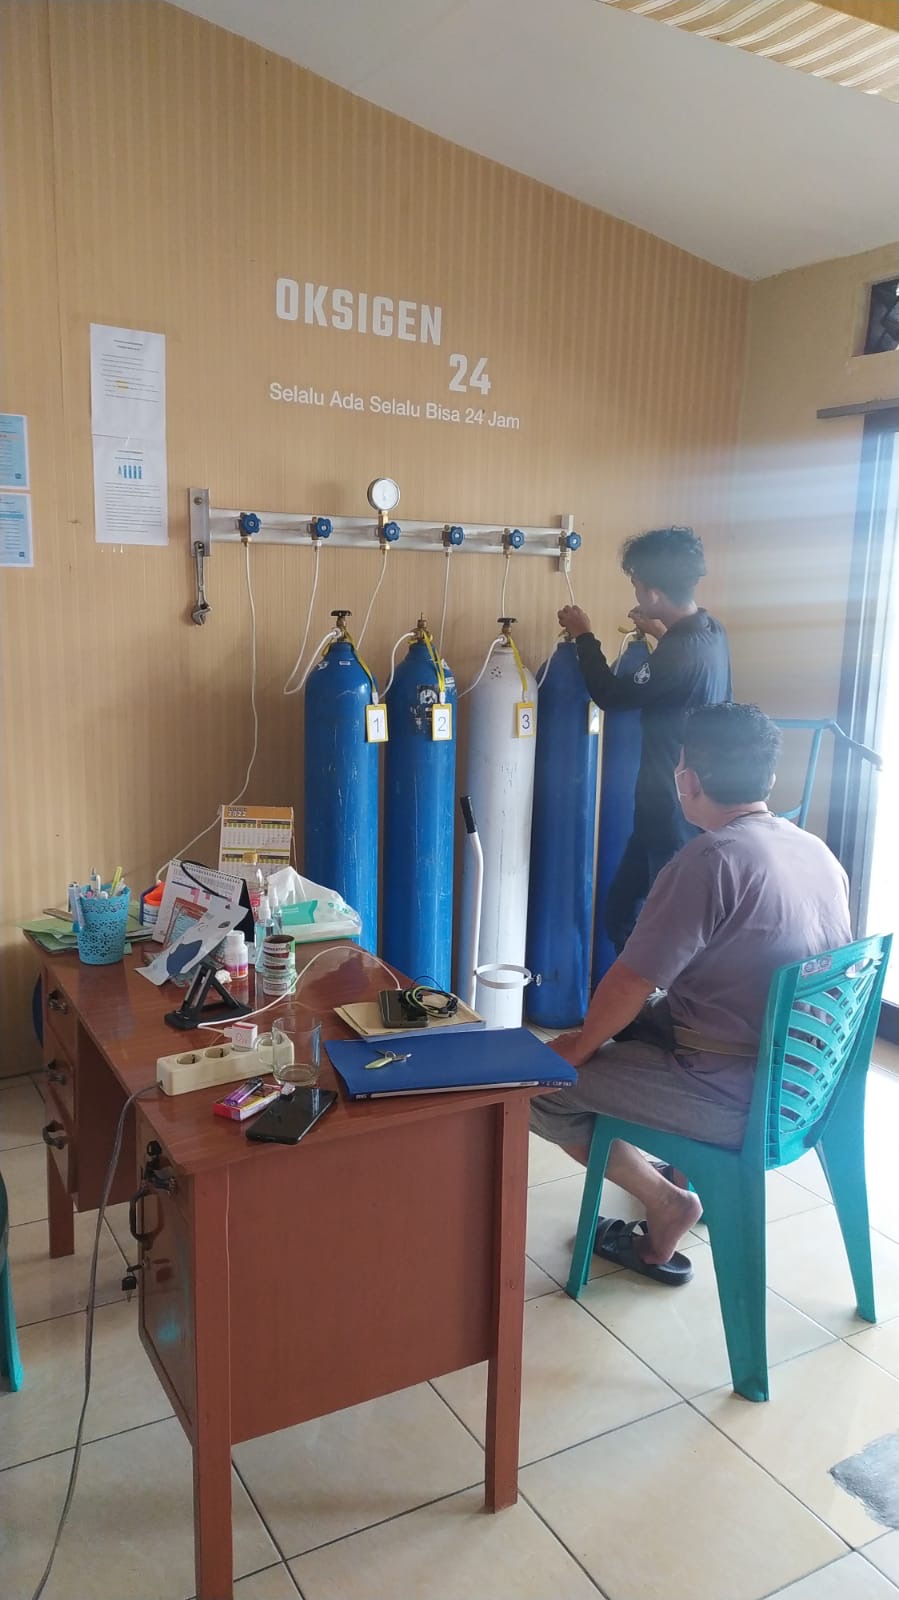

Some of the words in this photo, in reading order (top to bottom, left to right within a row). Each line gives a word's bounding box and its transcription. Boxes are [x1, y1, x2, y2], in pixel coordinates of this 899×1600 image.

[275, 278, 442, 346] OKSIGEN
[448, 353, 491, 395] 24
[269, 382, 324, 406] Selalu
[329, 391, 364, 411] Ada
[370, 396, 420, 417] Selalu
[426, 403, 460, 422] Bisa
[465, 407, 484, 424] 24
[488, 411, 520, 429] Jam
[373, 718, 380, 733] 1
[437, 716, 447, 732] 2
[521, 714, 531, 730] 3
